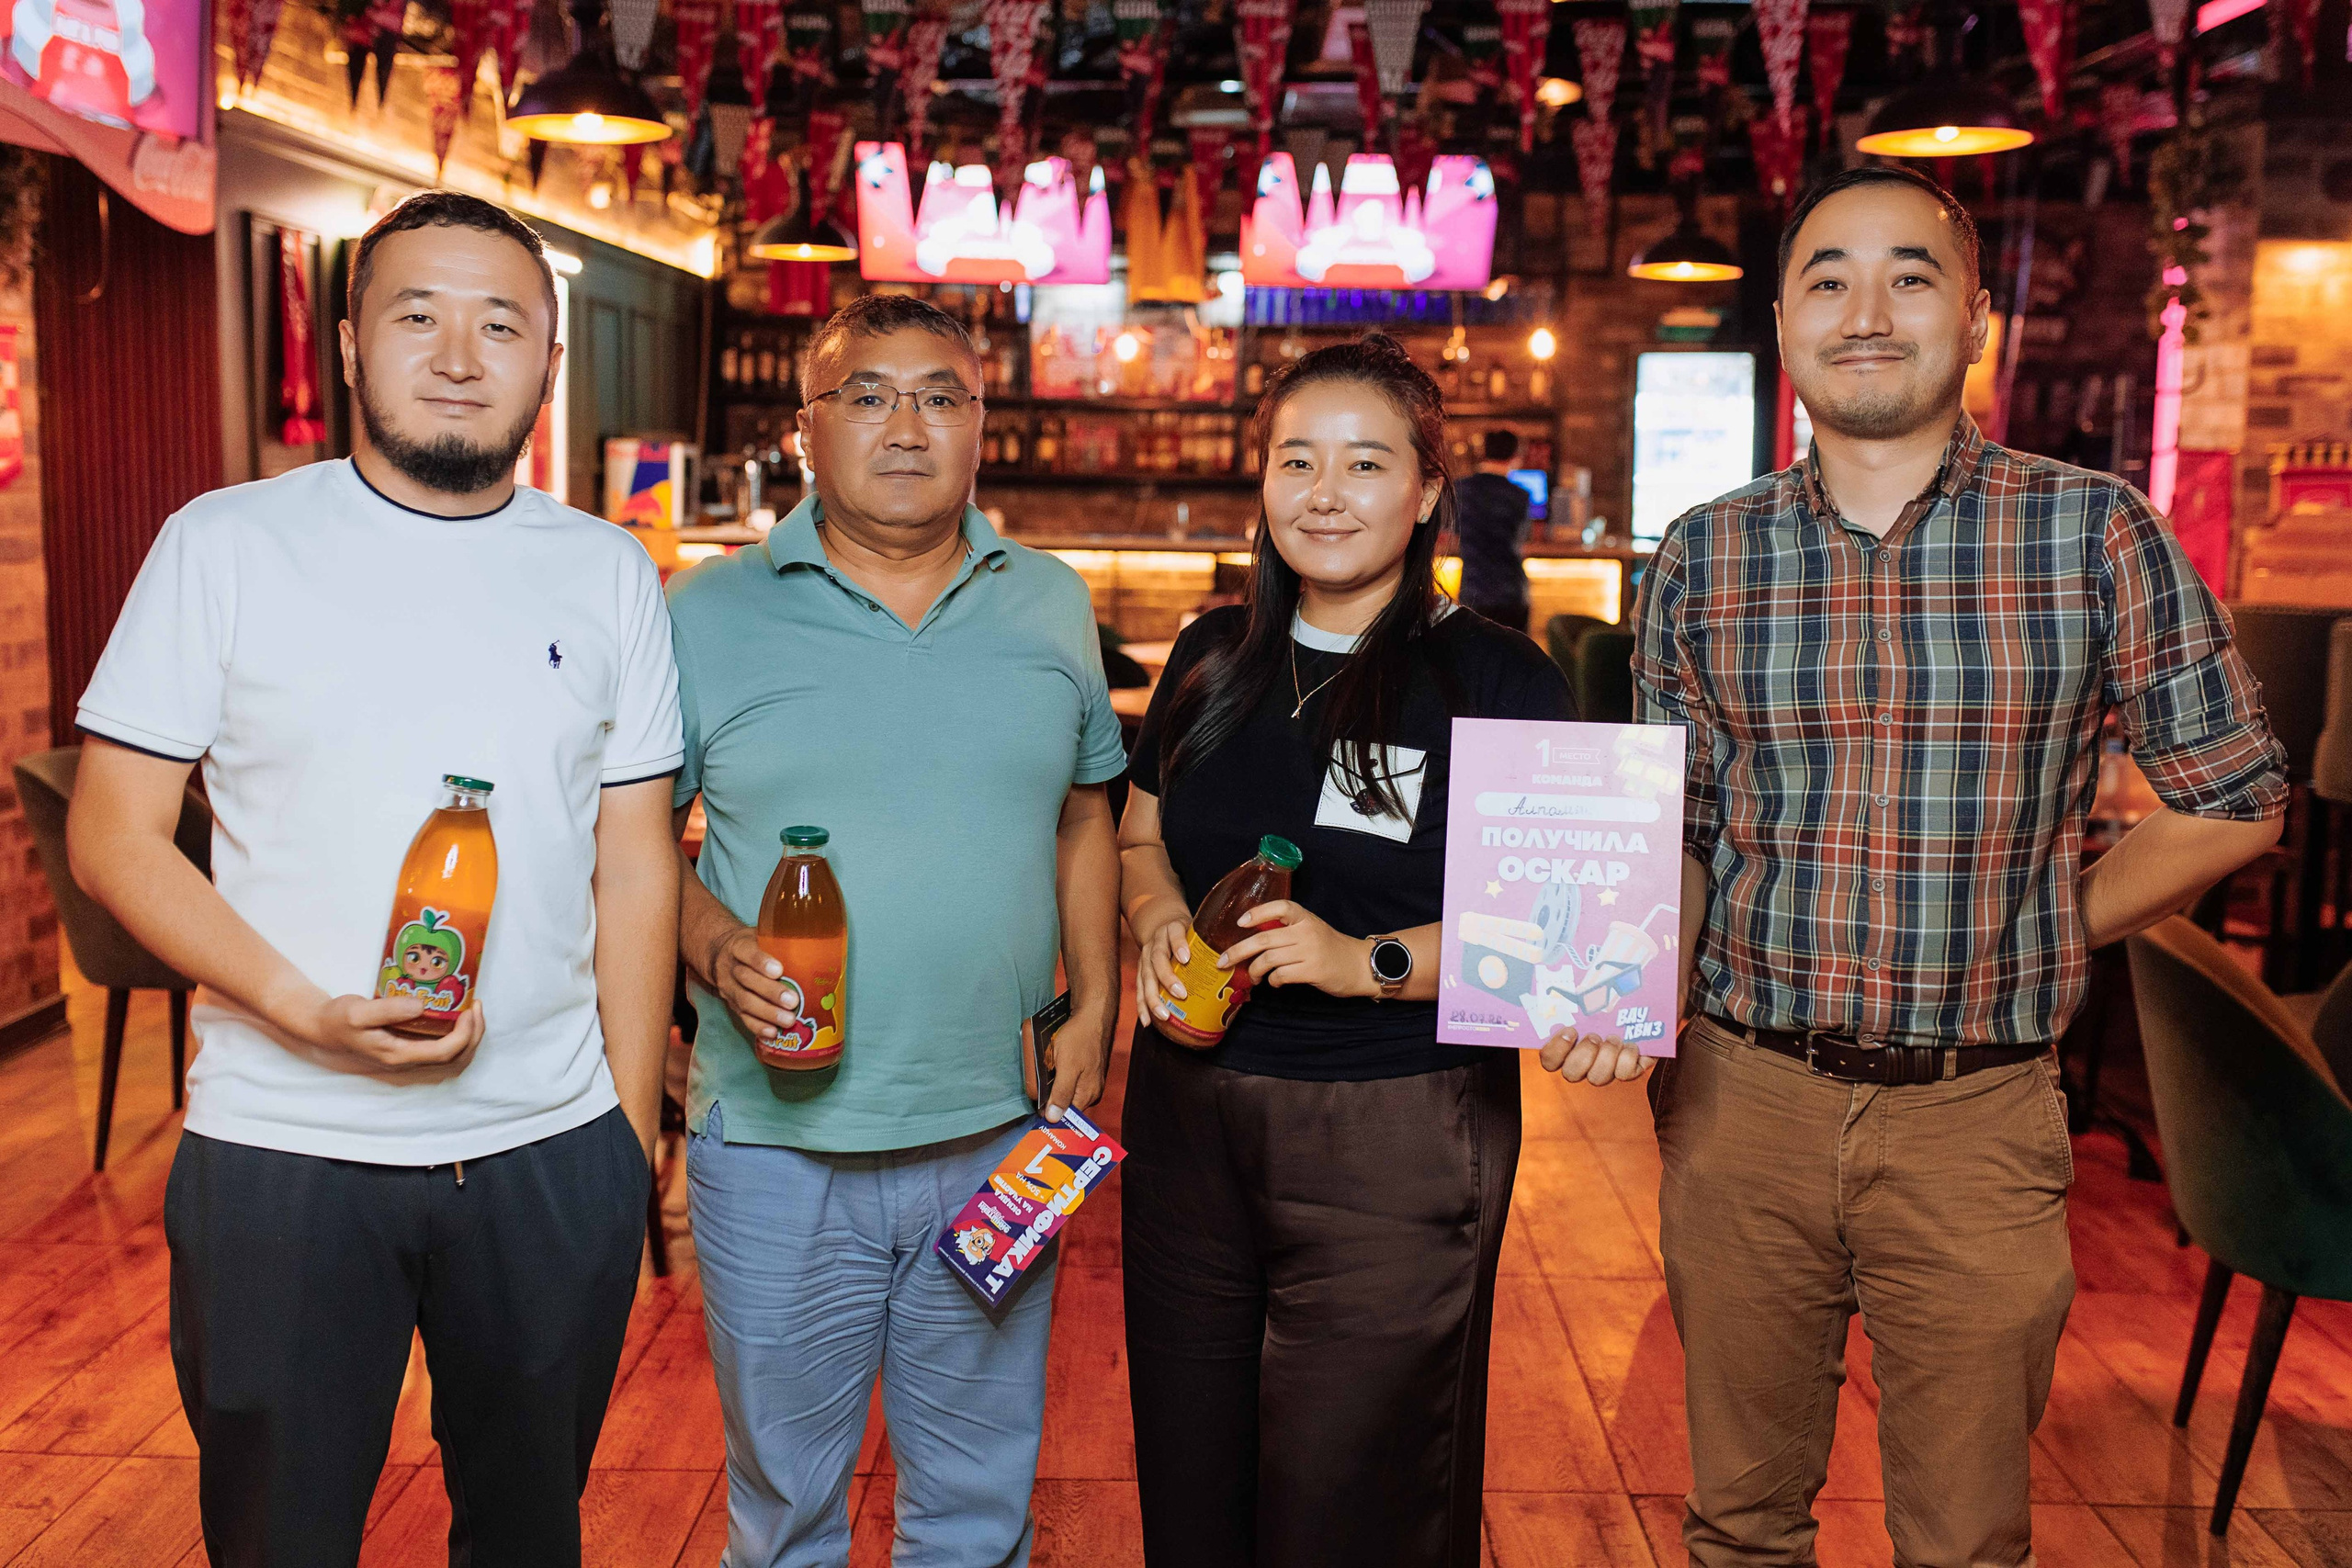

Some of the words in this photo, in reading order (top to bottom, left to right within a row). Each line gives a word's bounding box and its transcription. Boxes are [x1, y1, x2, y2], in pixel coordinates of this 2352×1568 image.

[1535, 739, 1550, 767] 1
[1560, 751, 1591, 761] МЕСТО
[1532, 773, 1602, 787] КОМАНДА
[1481, 826, 1649, 854] ПОЛУЧИЛА
[1498, 855, 1630, 886] ОСКАР
[1616, 1006, 1648, 1027] ВАУ
[775, 1034, 798, 1048] ruit
[1624, 1021, 1662, 1040] КВИЗ
[1038, 1125, 1067, 1151] КОМАНДУ
[1024, 1144, 1053, 1174] 1
[993, 1175, 1023, 1205] УЧАСТИЕ
[1015, 1171, 1026, 1183] НА
[1023, 1180, 1041, 1200] 50%
[994, 1189, 1023, 1216] СКИДКА
[1022, 1201, 1034, 1213] НА
[985, 1146, 1113, 1295] СЕРТИФИКАТ
